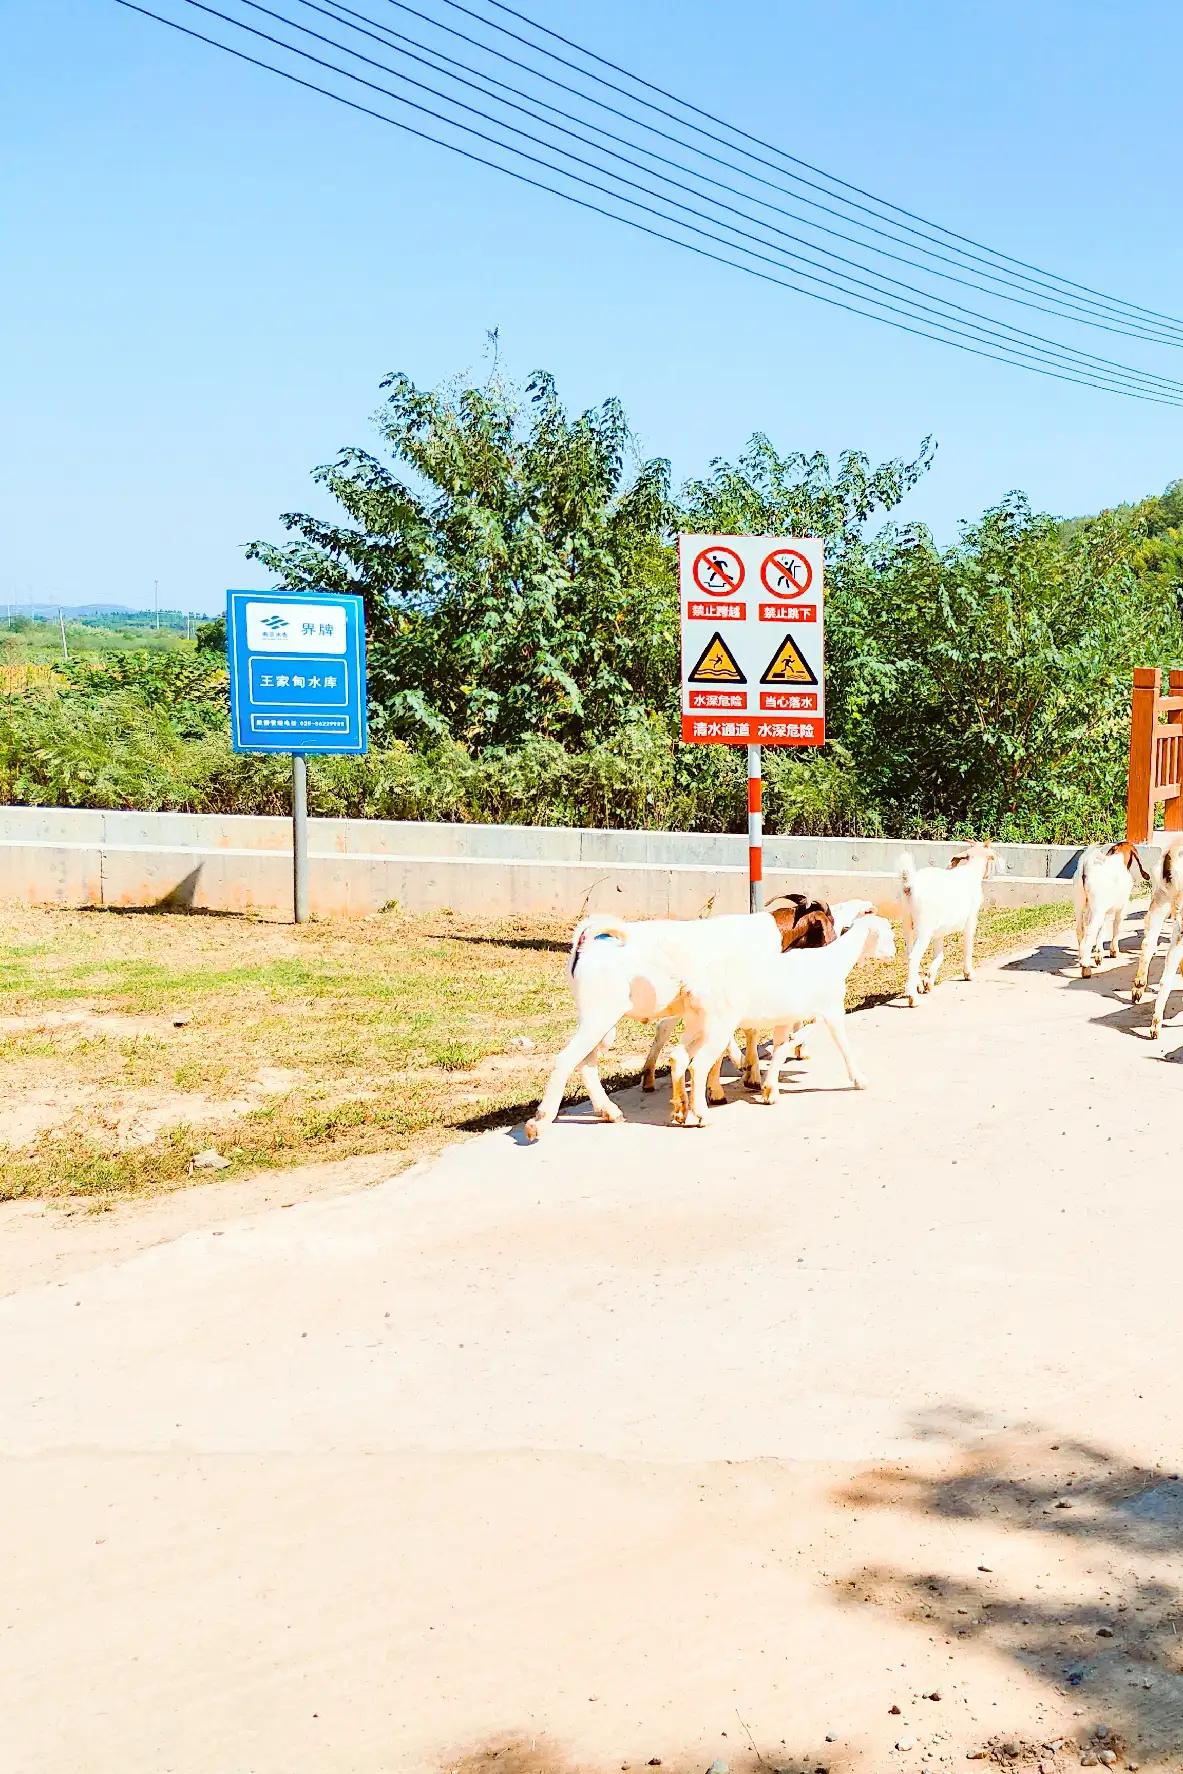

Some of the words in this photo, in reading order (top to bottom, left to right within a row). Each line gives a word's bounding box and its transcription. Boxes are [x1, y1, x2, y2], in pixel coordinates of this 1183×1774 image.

[692, 604, 741, 618] 禁止跨越
[764, 606, 812, 620] 禁止跳下
[301, 622, 334, 637] 界牌
[260, 674, 337, 689] 王家甸水库
[693, 694, 742, 707] 水深危险
[765, 696, 813, 709] 当心落水
[758, 722, 814, 738] 水深危险
